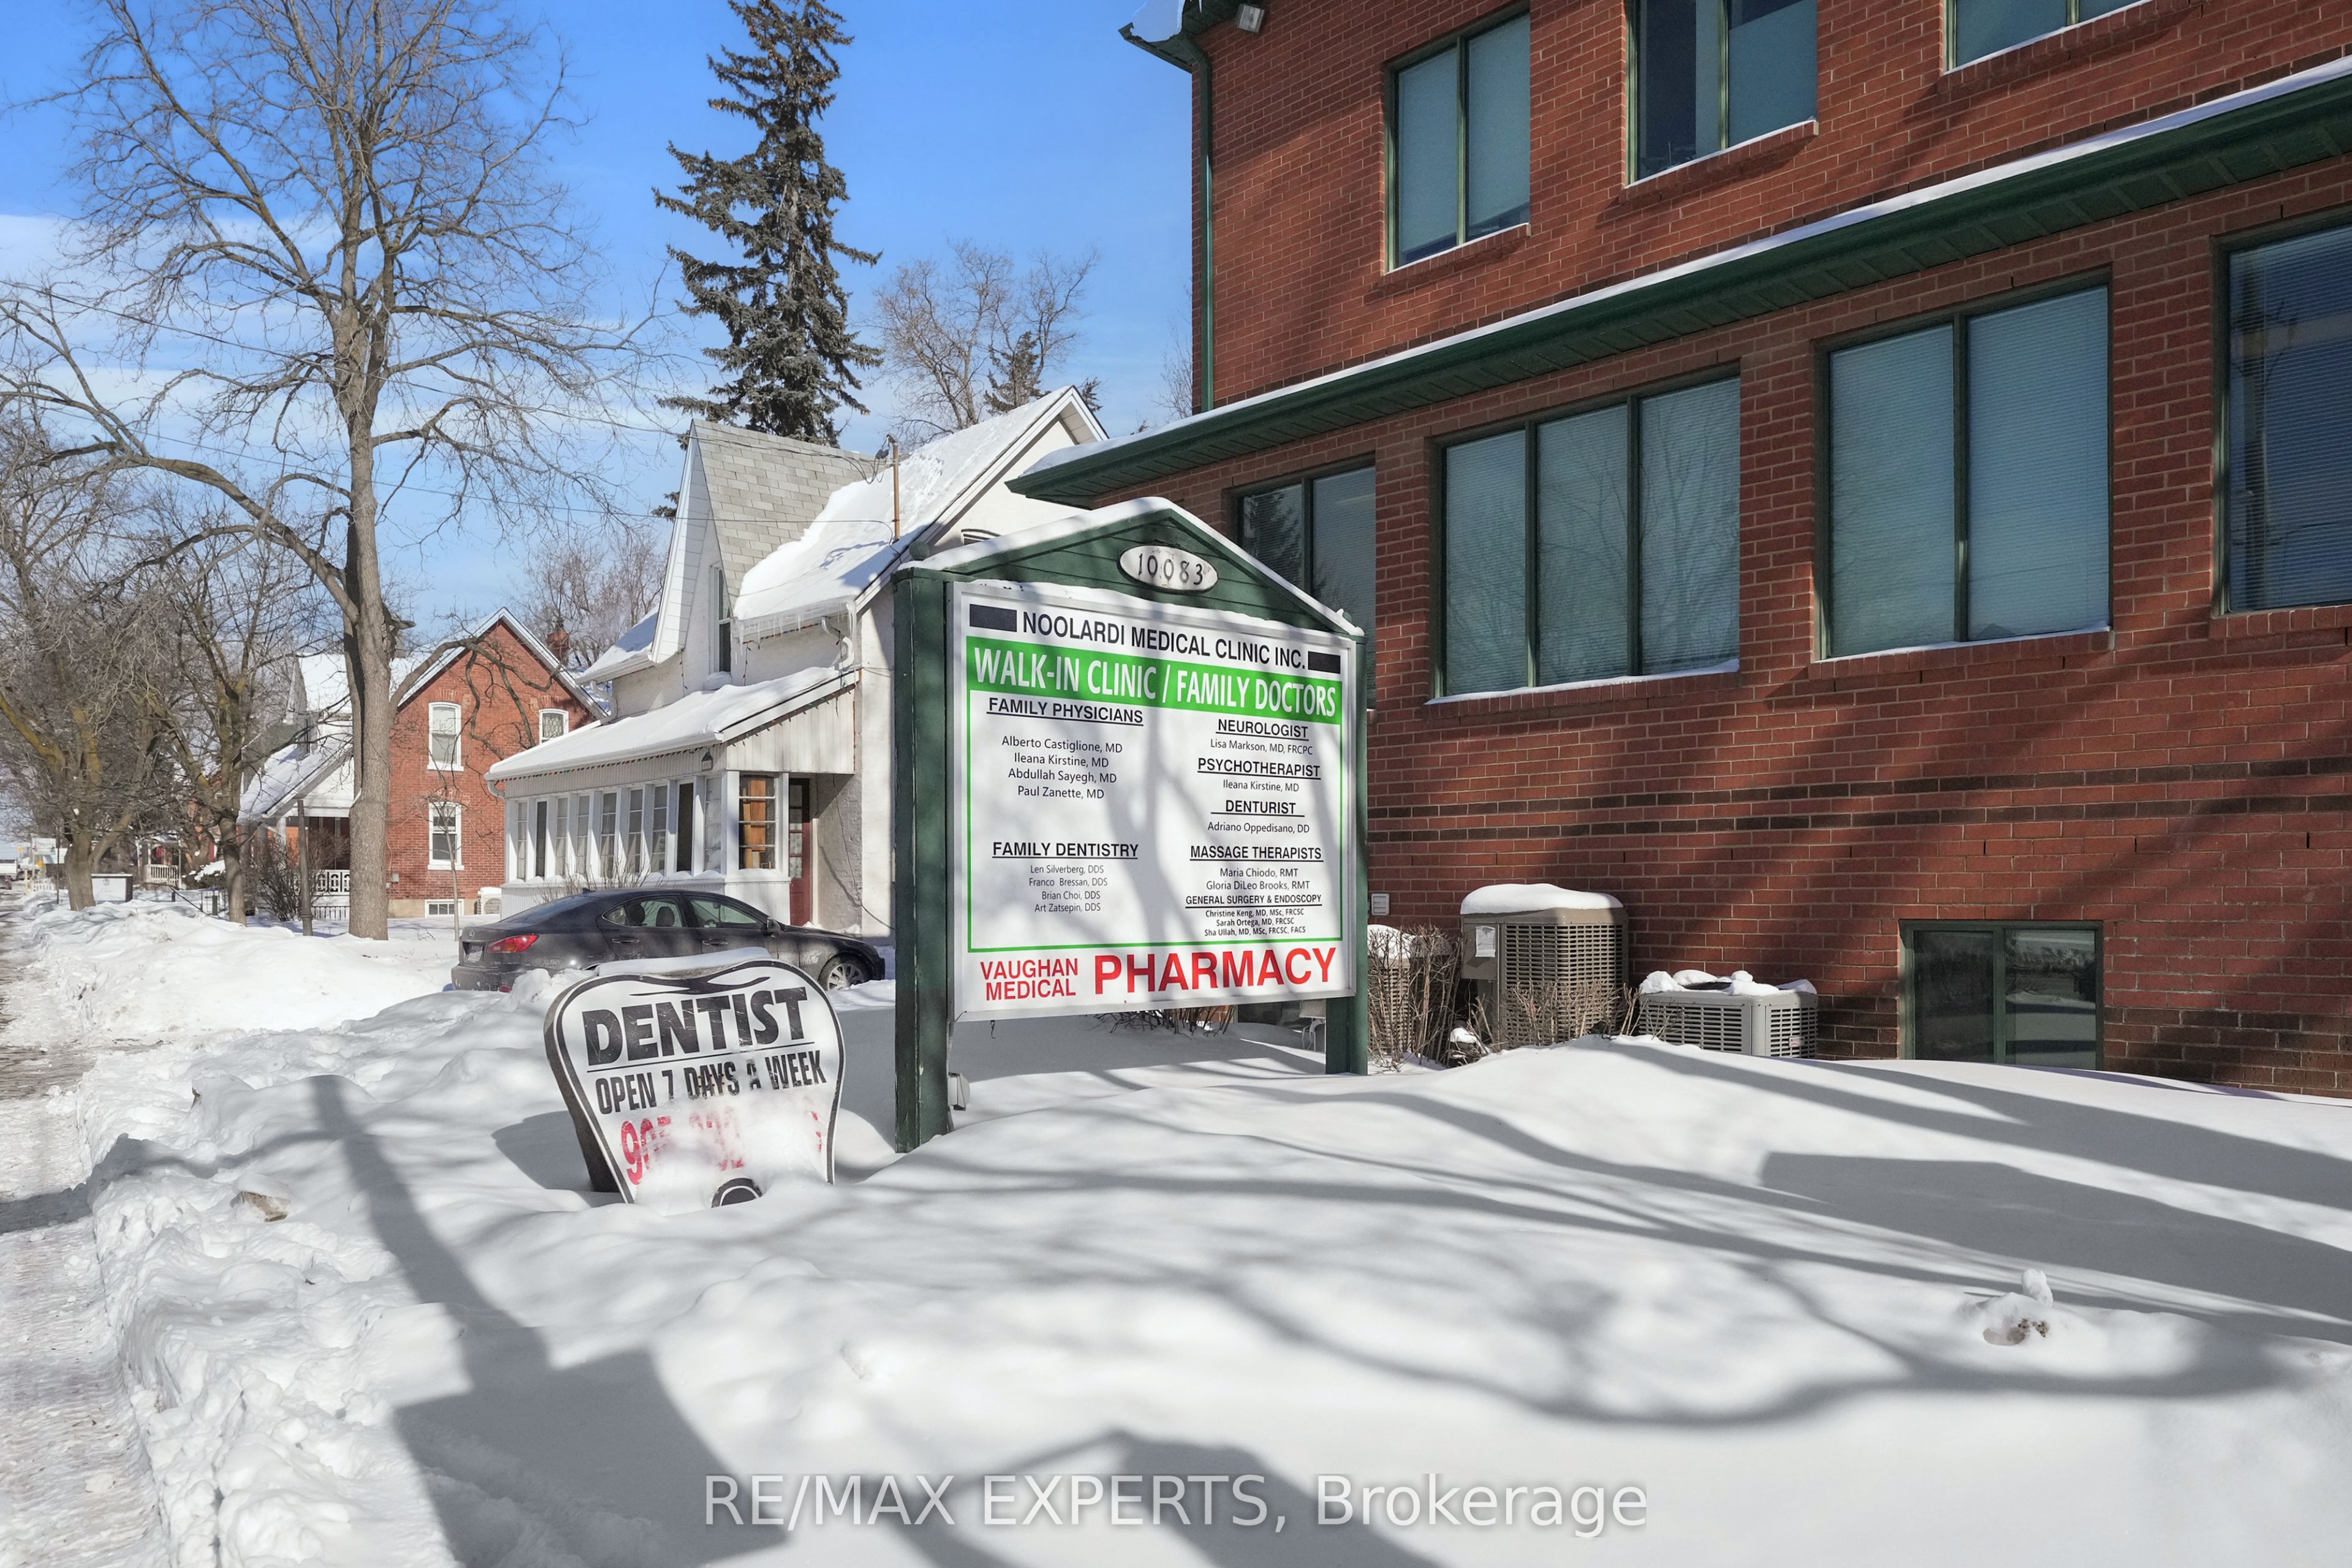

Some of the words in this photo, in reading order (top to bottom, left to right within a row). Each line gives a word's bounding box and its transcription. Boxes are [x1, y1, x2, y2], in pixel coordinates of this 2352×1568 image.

[1138, 553, 1202, 585] 10083
[1023, 611, 1125, 645] NOOLARDI
[1131, 626, 1211, 657] MEDICAL
[1215, 638, 1269, 664] CLINIC
[1275, 647, 1305, 669] INC.
[974, 647, 1079, 692] WALK-IN
[1087, 660, 1156, 699] CLINIC
[1163, 664, 1170, 703] /
[1177, 669, 1250, 708] FAMILY
[1256, 679, 1336, 717] DOCTORS
[989, 697, 1047, 715] FAMILY
[1052, 703, 1143, 723] PHYSICIANS
[1218, 718, 1308, 737] NEUROLOGIST
[1002, 736, 1041, 748] Alberto
[1044, 739, 1102, 753] Castiglione,
[1105, 742, 1123, 753] MD
[1211, 739, 1226, 748] Lisa
[1229, 741, 1267, 752] Markson,
[1270, 743, 1285, 754] MD,
[1287, 745, 1313, 755] FRCPC
[1014, 752, 1045, 764] Ileana
[1048, 755, 1088, 767] Kirstine,
[1091, 757, 1109, 767] MD
[1198, 757, 1320, 777] PSYCHOTHERAPIST
[1008, 768, 1055, 780] Abdullah
[1058, 771, 1096, 784] Sayegh,
[1099, 773, 1117, 783] MD
[1018, 785, 1039, 796] Paul
[1042, 786, 1084, 799] Zanette,
[1087, 789, 1104, 799] MD
[1223, 779, 1248, 790] Ileana
[1250, 781, 1283, 792] Kirstine,
[1285, 783, 1299, 792] MD
[1226, 799, 1296, 814] DENTURIST
[1207, 821, 1242, 831] Adriano
[1244, 823, 1295, 834] Oppedisano,
[1297, 824, 1310, 833] DD
[993, 842, 1051, 856] FAMILY
[1056, 843, 1139, 857] DENTISTRY
[1191, 845, 1248, 858] MASSAGE
[1252, 846, 1322, 859] THERAPISTS
[1030, 865, 1044, 873] Len
[1047, 865, 1085, 875] Silverberg,
[1088, 865, 1104, 874] DDS
[1220, 868, 1243, 877] Maria
[1246, 868, 1277, 878] Chiodo,
[1280, 869, 1298, 877] RMT
[1029, 878, 1055, 886] Franco
[1060, 878, 1090, 887] Bressan,
[1091, 878, 1107, 886] DDS
[1206, 881, 1231, 890] Gloria
[1234, 881, 1257, 889] DiLeo
[1260, 881, 1289, 891] Brooks,
[1292, 881, 1310, 889] RMT
[1042, 891, 1061, 900] Brian
[1063, 891, 1082, 900] Choi,
[1085, 891, 1101, 900] DDS
[1186, 895, 1224, 905] GENERAL
[1227, 895, 1264, 904] SURGERY
[1275, 894, 1322, 903] ENDOSCOPY
[1035, 903, 1046, 912] Art
[1049, 903, 1083, 914] Zatsepin,
[1085, 902, 1101, 911] DDS
[1237, 910, 1254, 918] Keng,
[979, 957, 1079, 981] VAUGHAN
[1095, 947, 1337, 995] PHARMACY
[986, 979, 1076, 1001] MEDICAL
[581, 987, 807, 1066] DENTIST
[595, 1072, 657, 1115] OPEN
[662, 1069, 674, 1101] 7
[684, 1061, 740, 1099] DAYS
[764, 1050, 827, 1091] WEEK
